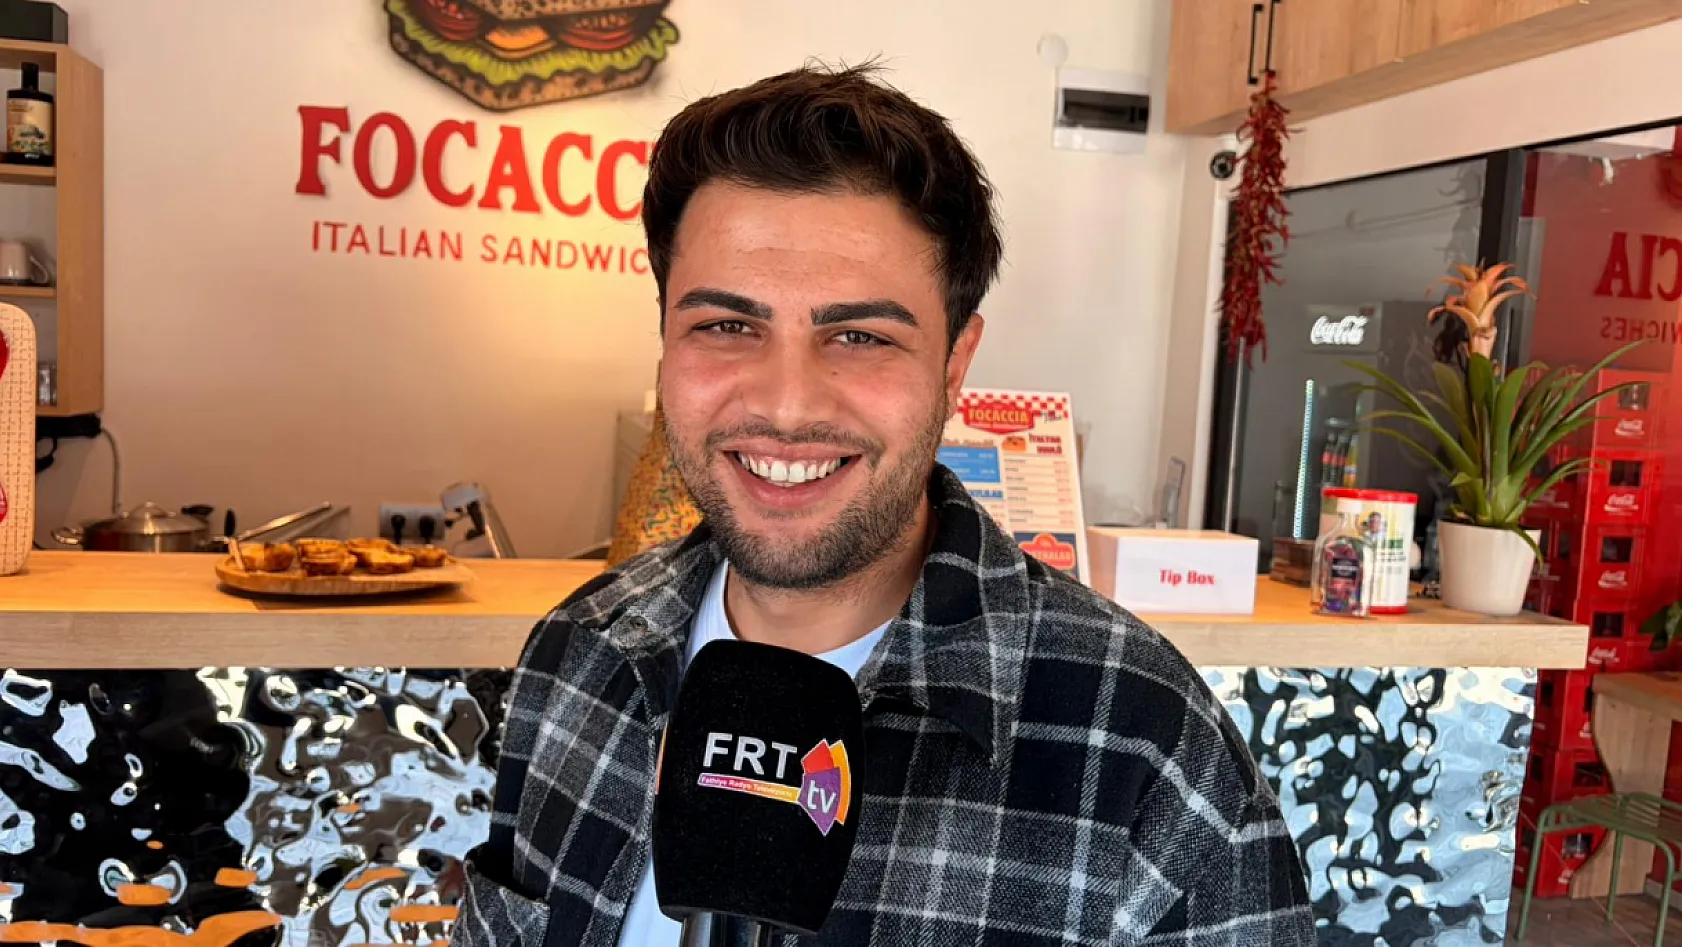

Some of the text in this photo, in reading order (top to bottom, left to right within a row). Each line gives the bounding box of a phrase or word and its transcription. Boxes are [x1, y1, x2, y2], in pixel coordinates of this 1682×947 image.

[296, 105, 654, 221] FOCACC
[311, 220, 463, 261] ITALIAN
[968, 407, 1028, 425] FOCACCIA
[1159, 568, 1215, 587] Tip Box
[702, 732, 798, 780] FRT
[807, 779, 837, 814] tv
